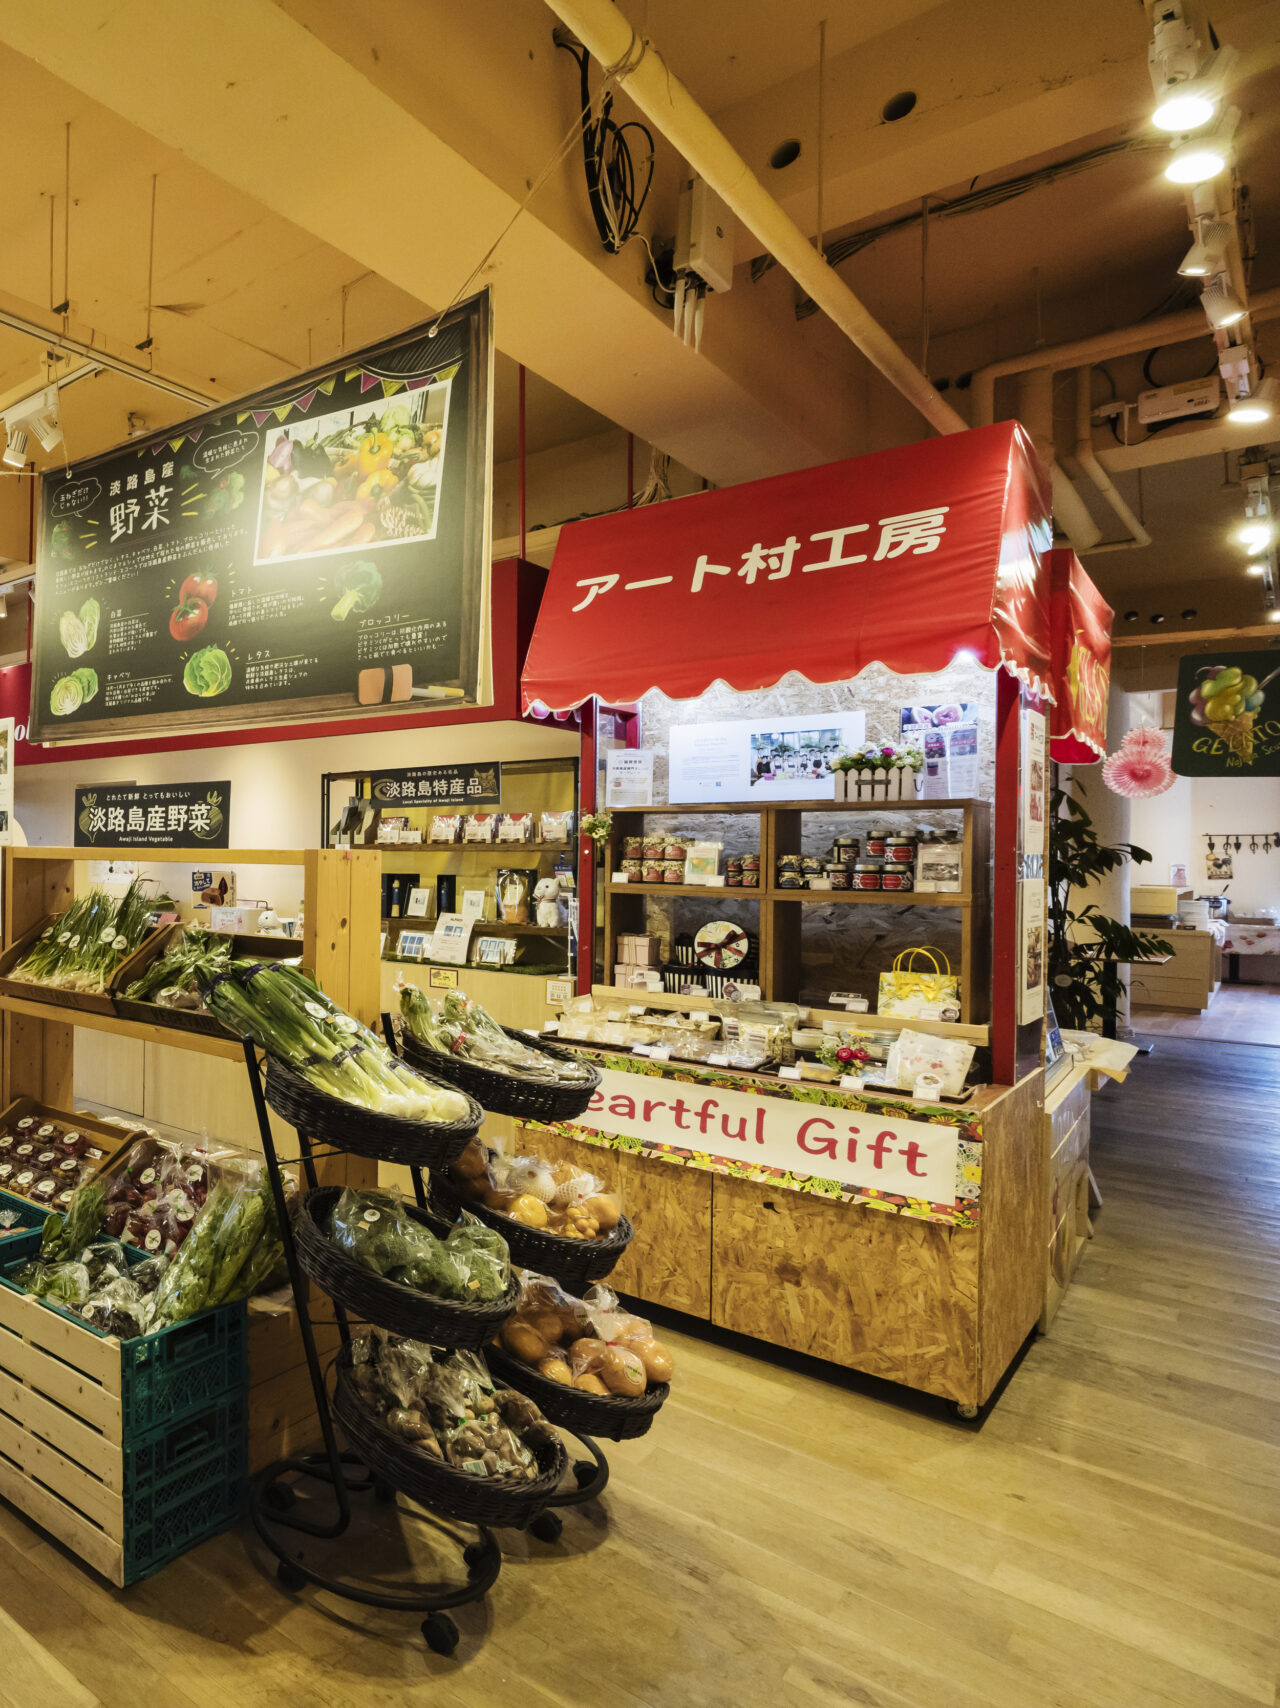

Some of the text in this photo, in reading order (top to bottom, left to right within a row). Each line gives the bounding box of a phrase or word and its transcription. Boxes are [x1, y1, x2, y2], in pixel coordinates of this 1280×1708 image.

[109, 461, 175, 497] 淡路島産
[109, 485, 174, 544] 野菜
[571, 505, 951, 613] アート村工房
[231, 586, 253, 598] トマト
[110, 609, 122, 619] 白菜
[359, 613, 410, 628] ブロッコリー
[247, 650, 271, 661] レタス
[106, 671, 131, 681] キャベツ
[386, 777, 482, 798] 淡路島特産品
[106, 791, 191, 801] とれたて新鮮 とってもおいしい
[88, 803, 211, 832] 淡路島産野菜
[148, 835, 174, 843] Vegetable
[587, 1088, 928, 1178] eartful Gift
